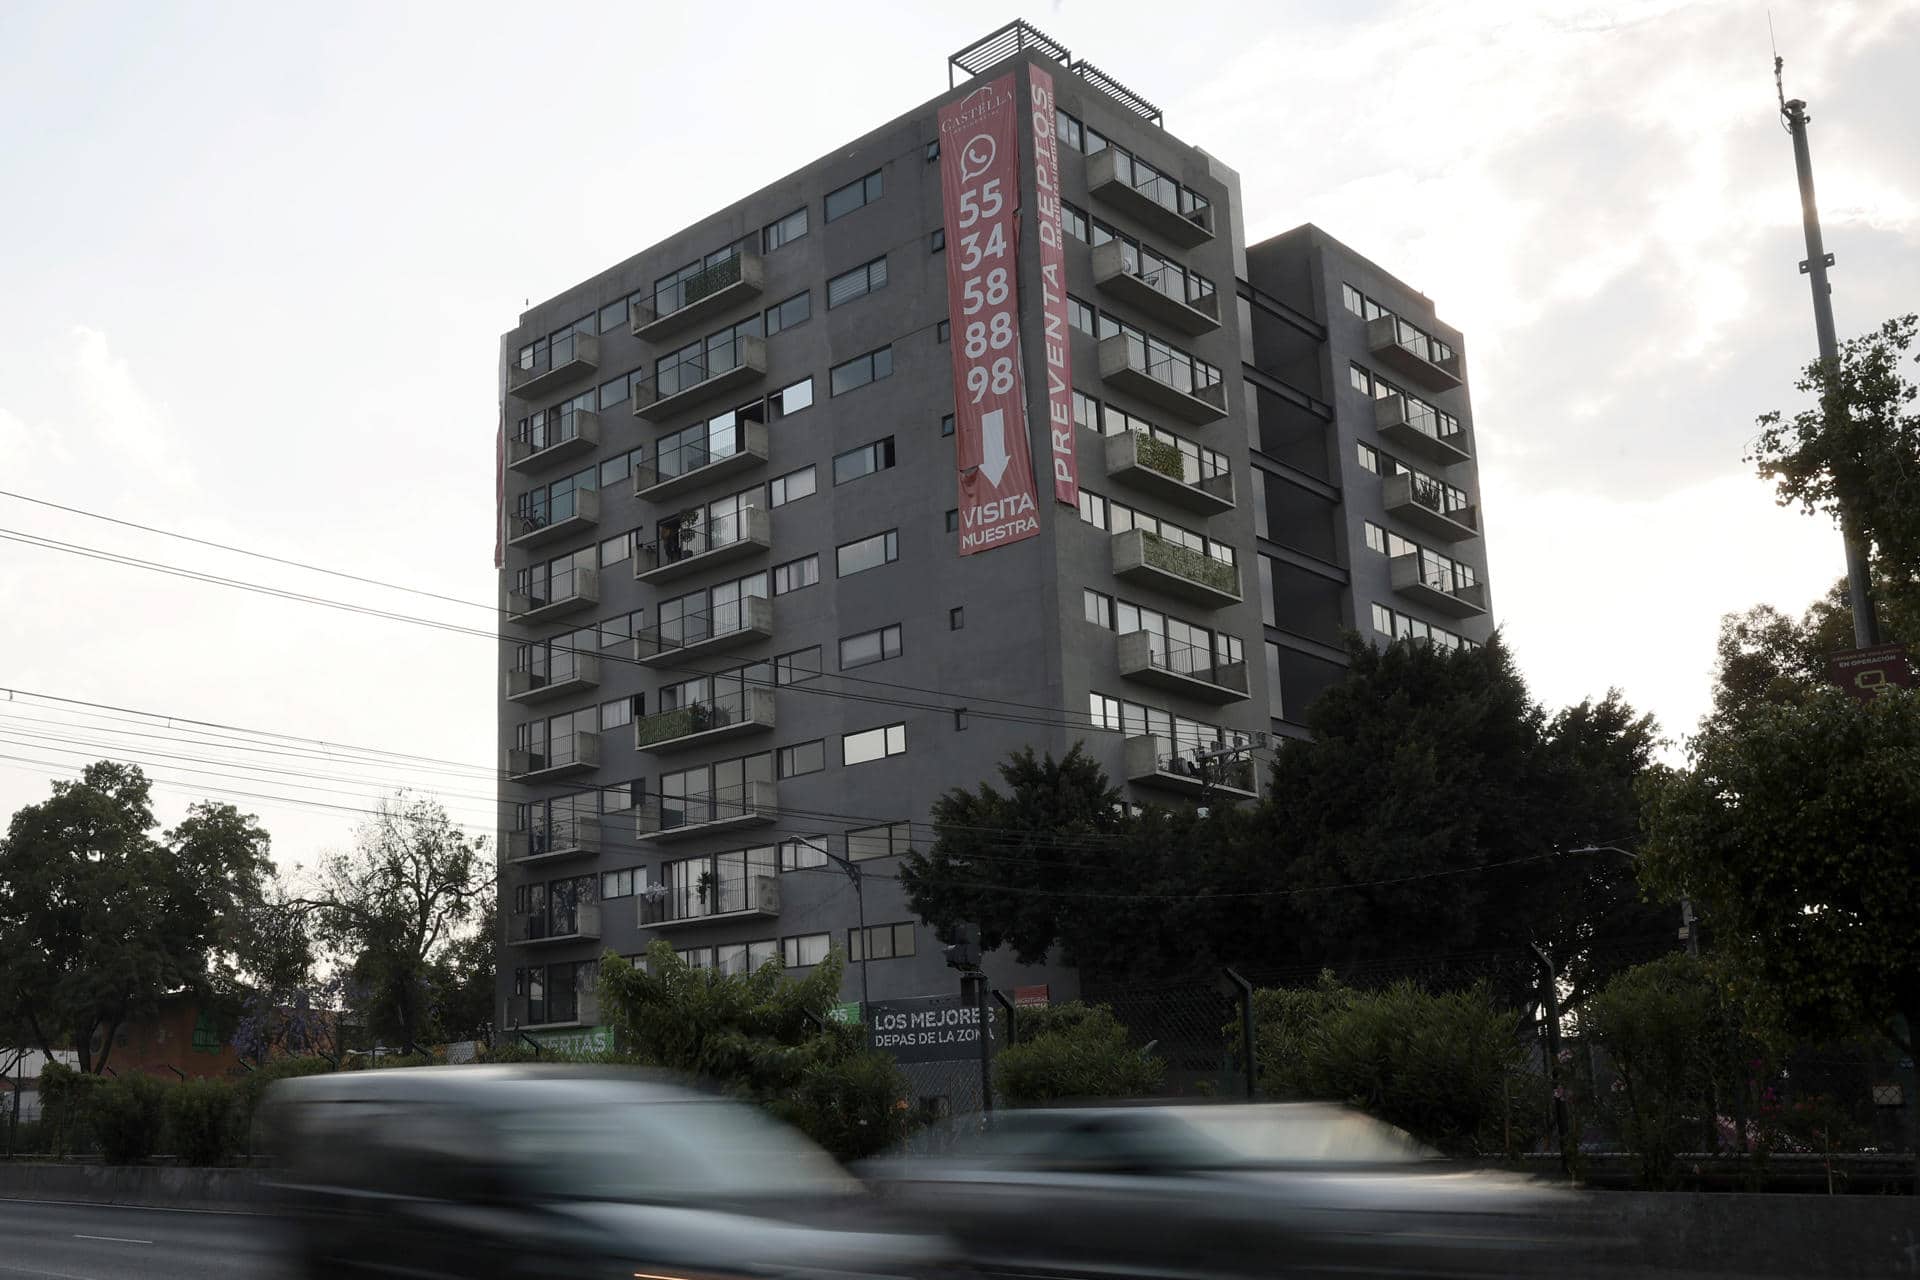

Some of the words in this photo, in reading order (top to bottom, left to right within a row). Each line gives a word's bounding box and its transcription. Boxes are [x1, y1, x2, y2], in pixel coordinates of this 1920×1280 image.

[941, 91, 1013, 133] CASTELLA
[1032, 84, 1057, 248] DEPTOS
[959, 178, 1003, 229] 55
[960, 222, 1007, 271] 34
[963, 267, 1009, 315] 58
[964, 311, 1013, 359] 88
[967, 356, 1014, 404] 98
[1042, 263, 1073, 483] PREVENTA
[962, 492, 1035, 528] VISITA
[962, 517, 1039, 549] MUESTRA
[875, 1014, 907, 1031] LOS
[875, 1033, 916, 1047] DEPAS
[919, 1032, 936, 1045] DE
[938, 1031, 955, 1043] LA
